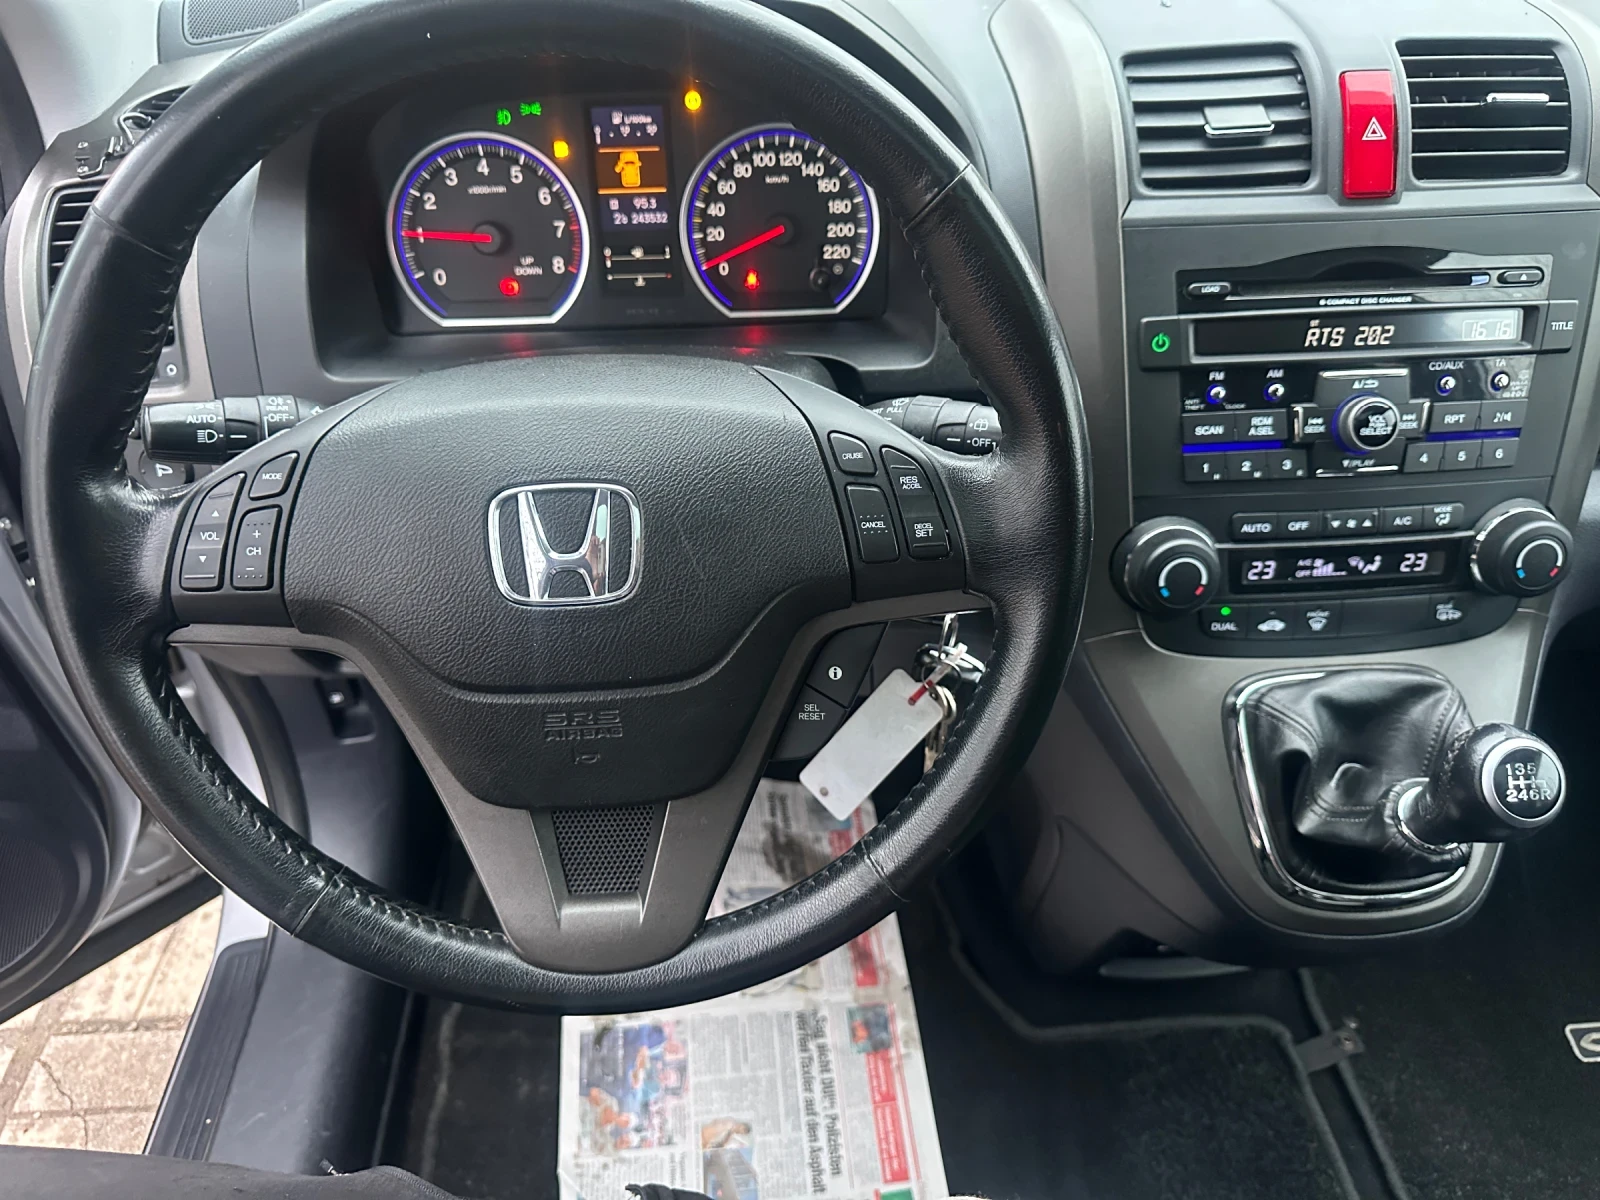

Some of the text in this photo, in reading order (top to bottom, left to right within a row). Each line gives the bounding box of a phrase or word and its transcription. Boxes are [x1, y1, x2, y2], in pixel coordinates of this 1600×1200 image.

[752, 152, 776, 167] 100
[779, 152, 802, 166] 120
[477, 159, 490, 176] 4
[734, 164, 752, 178] 80
[801, 163, 824, 177] 140
[444, 168, 458, 186] 3
[510, 166, 523, 184] 5
[765, 175, 790, 184] km/h
[717, 180, 736, 194] 60
[818, 178, 840, 193] 160
[423, 193, 436, 210] 2
[538, 188, 551, 205] 6
[707, 202, 726, 216] 40
[828, 200, 852, 214] 180
[553, 220, 566, 238] 7
[706, 226, 724, 242] 20
[827, 223, 855, 238] 200
[823, 245, 851, 259] 220
[520, 256, 534, 265] UP
[552, 257, 565, 274] 8
[514, 266, 542, 276] DOWN
[718, 262, 729, 276] 0
[433, 268, 447, 285] 0
[1201, 285, 1220, 293] LOAD
[1378, 296, 1412, 304] CHANGER
[1551, 322, 1574, 330] TITLE
[1304, 325, 1395, 347] RTS 202
[1428, 361, 1464, 371] CD/AUX
[1209, 371, 1225, 381] FM
[1266, 368, 1284, 378] AM
[886, 406, 903, 414] PULL
[186, 414, 216, 424] AUTO
[268, 414, 288, 422] OFF
[1250, 416, 1274, 426] RDM
[1368, 415, 1385, 423] VOL
[1444, 414, 1466, 424] RPT
[1194, 425, 1224, 436] SCAN
[1304, 425, 1326, 434] SEEK
[1398, 421, 1418, 429] SEEK
[1360, 427, 1392, 436] SELECT
[972, 437, 992, 448] OFF
[842, 452, 864, 460] CRUISE
[1419, 454, 1428, 463] 4
[1458, 450, 1466, 462] 5
[1496, 448, 1504, 459] 6
[1202, 462, 1210, 474] 1
[1240, 460, 1252, 472] 2
[1282, 459, 1293, 470] 3
[262, 472, 282, 480] MODE
[900, 476, 918, 484] RES
[1288, 520, 1310, 531] OFF
[1393, 516, 1412, 526] A/C
[1240, 522, 1272, 533] AUTO
[200, 532, 220, 540] VOL
[915, 529, 934, 538] SET
[246, 547, 262, 556] CH
[1400, 552, 1428, 572] 23
[1248, 560, 1277, 580] 23
[1211, 622, 1238, 631] DUAL
[804, 704, 820, 712] SEL
[798, 712, 826, 720] RESET
[1506, 762, 1536, 776] 1 3 5
[1506, 788, 1551, 802] 2 4 6 R
[824, 1114, 844, 1176] Polizisten
[808, 1145, 827, 1194] Asphalt
